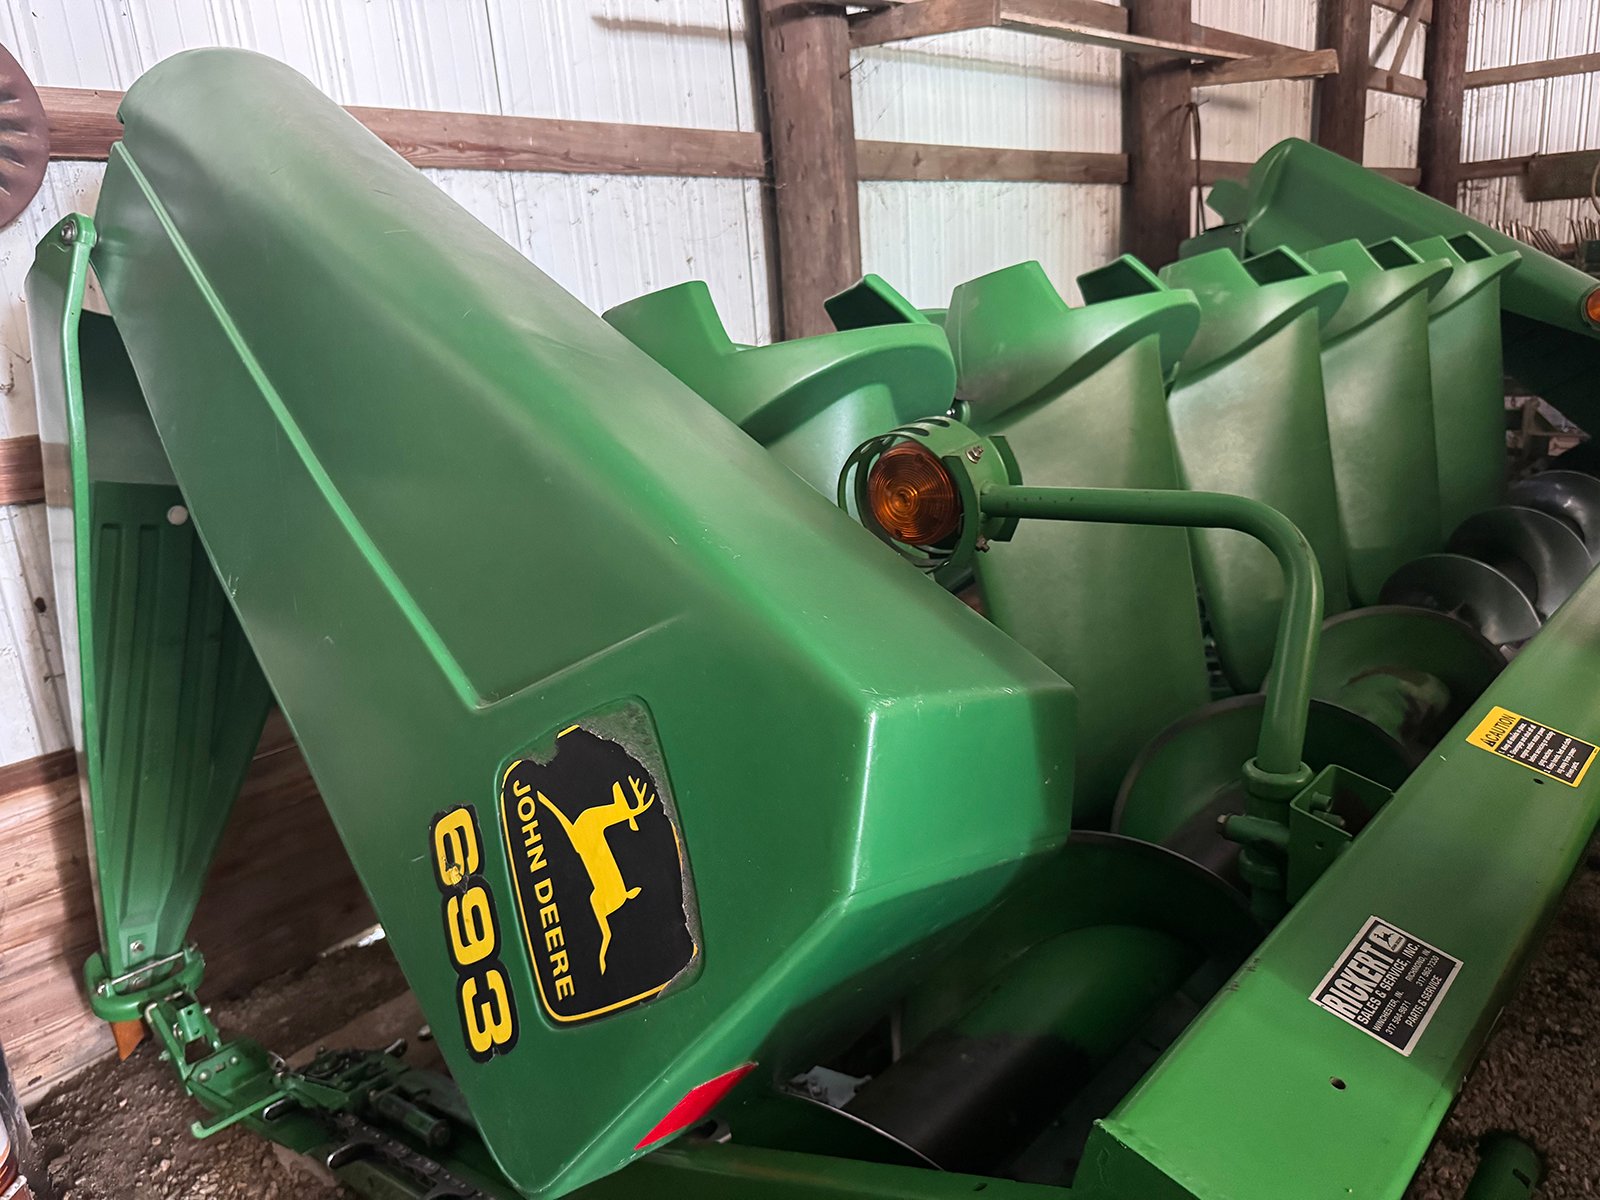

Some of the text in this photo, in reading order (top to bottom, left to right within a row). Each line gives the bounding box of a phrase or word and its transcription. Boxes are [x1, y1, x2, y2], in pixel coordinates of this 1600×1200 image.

[1485, 714, 1516, 742] CAUTION
[512, 779, 575, 1002] JOHN DEERE
[434, 808, 512, 1053] 693
[1402, 941, 1420, 959] INC.
[1321, 942, 1395, 1020] RICKERT
[1379, 956, 1411, 992] SERVICE,
[1415, 976, 1427, 987] 317
[1374, 989, 1387, 999] &
[1404, 974, 1443, 1027] PARTS & SERVICE
[1356, 996, 1382, 1025] SALES
[1372, 997, 1400, 1032] WINCHESTER,
[1385, 1023, 1397, 1035] 317
